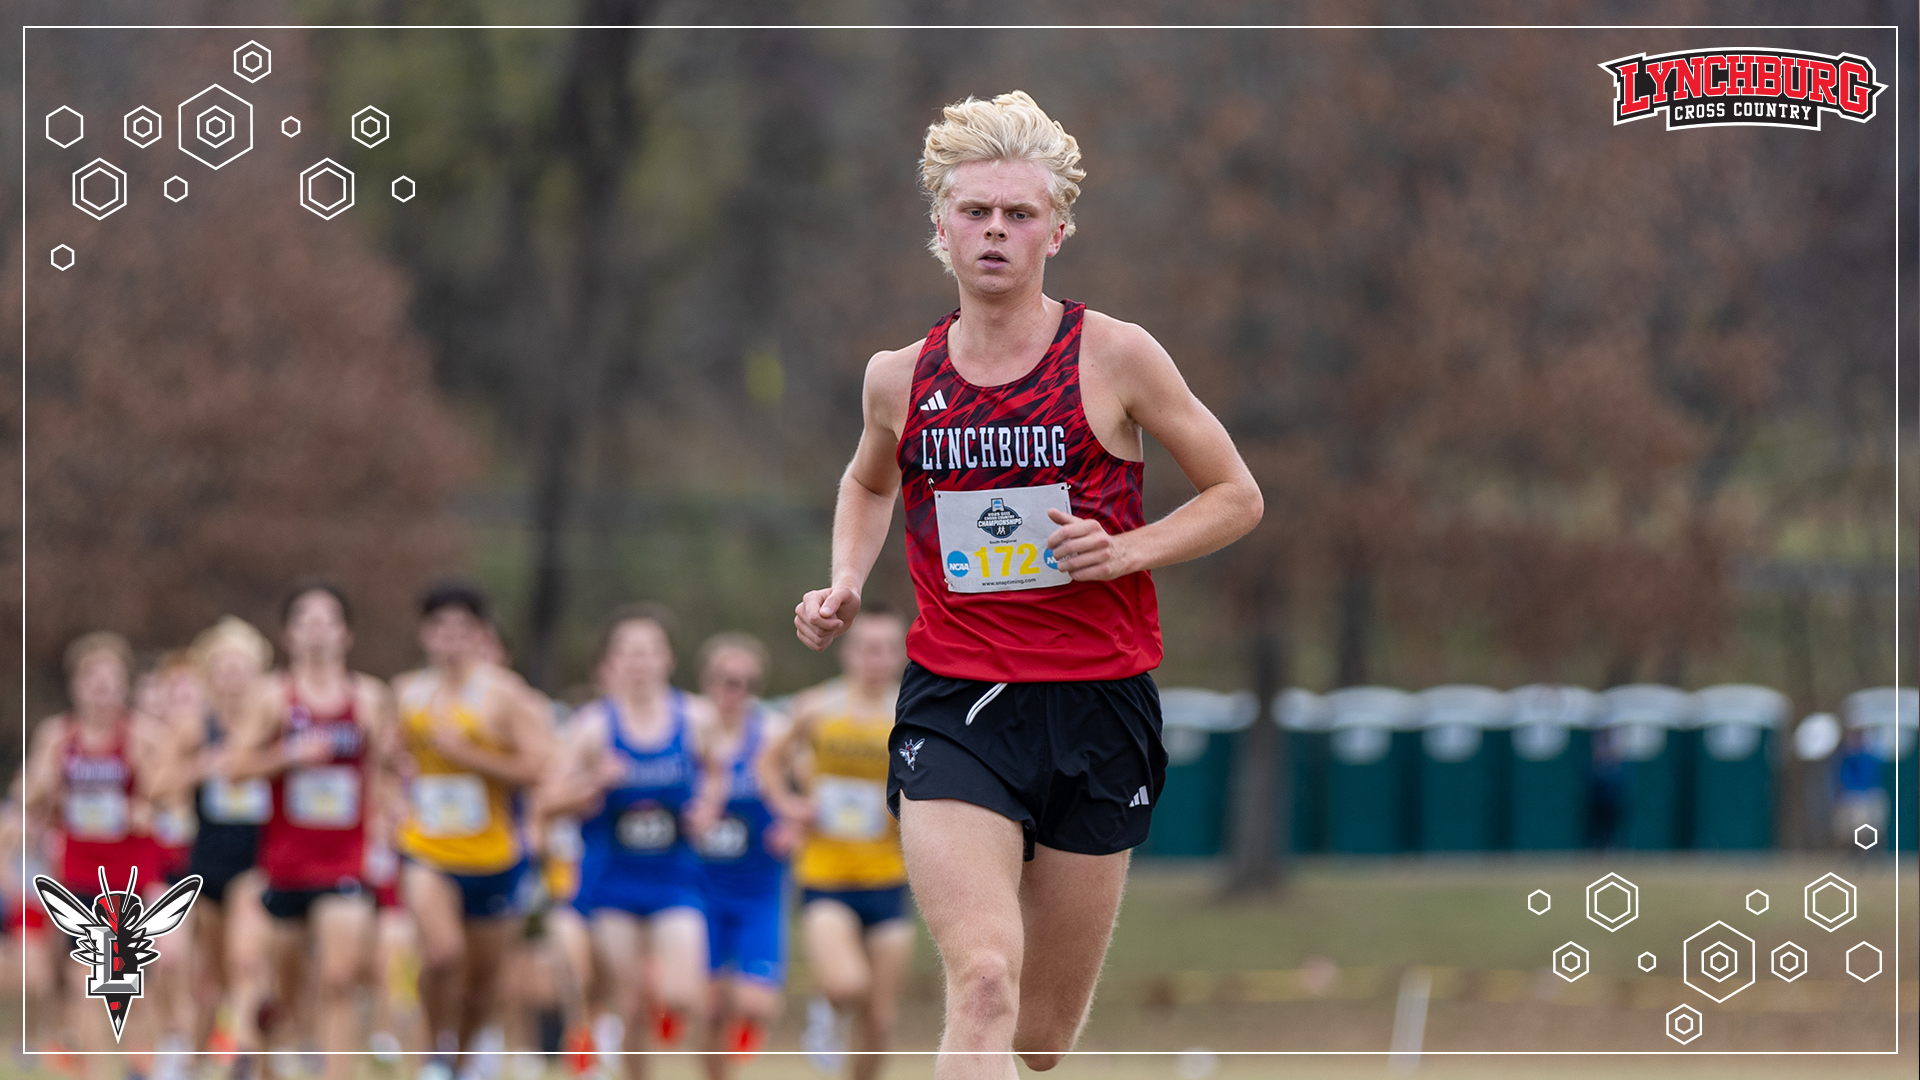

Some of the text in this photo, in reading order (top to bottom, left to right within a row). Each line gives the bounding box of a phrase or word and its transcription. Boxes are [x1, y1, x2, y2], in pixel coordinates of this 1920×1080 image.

[921, 425, 1066, 470] LYNCHBURG
[978, 518, 1022, 527] CHAMPIONSHIPS
[949, 562, 970, 571] NCAA
[974, 543, 1040, 578] 172
